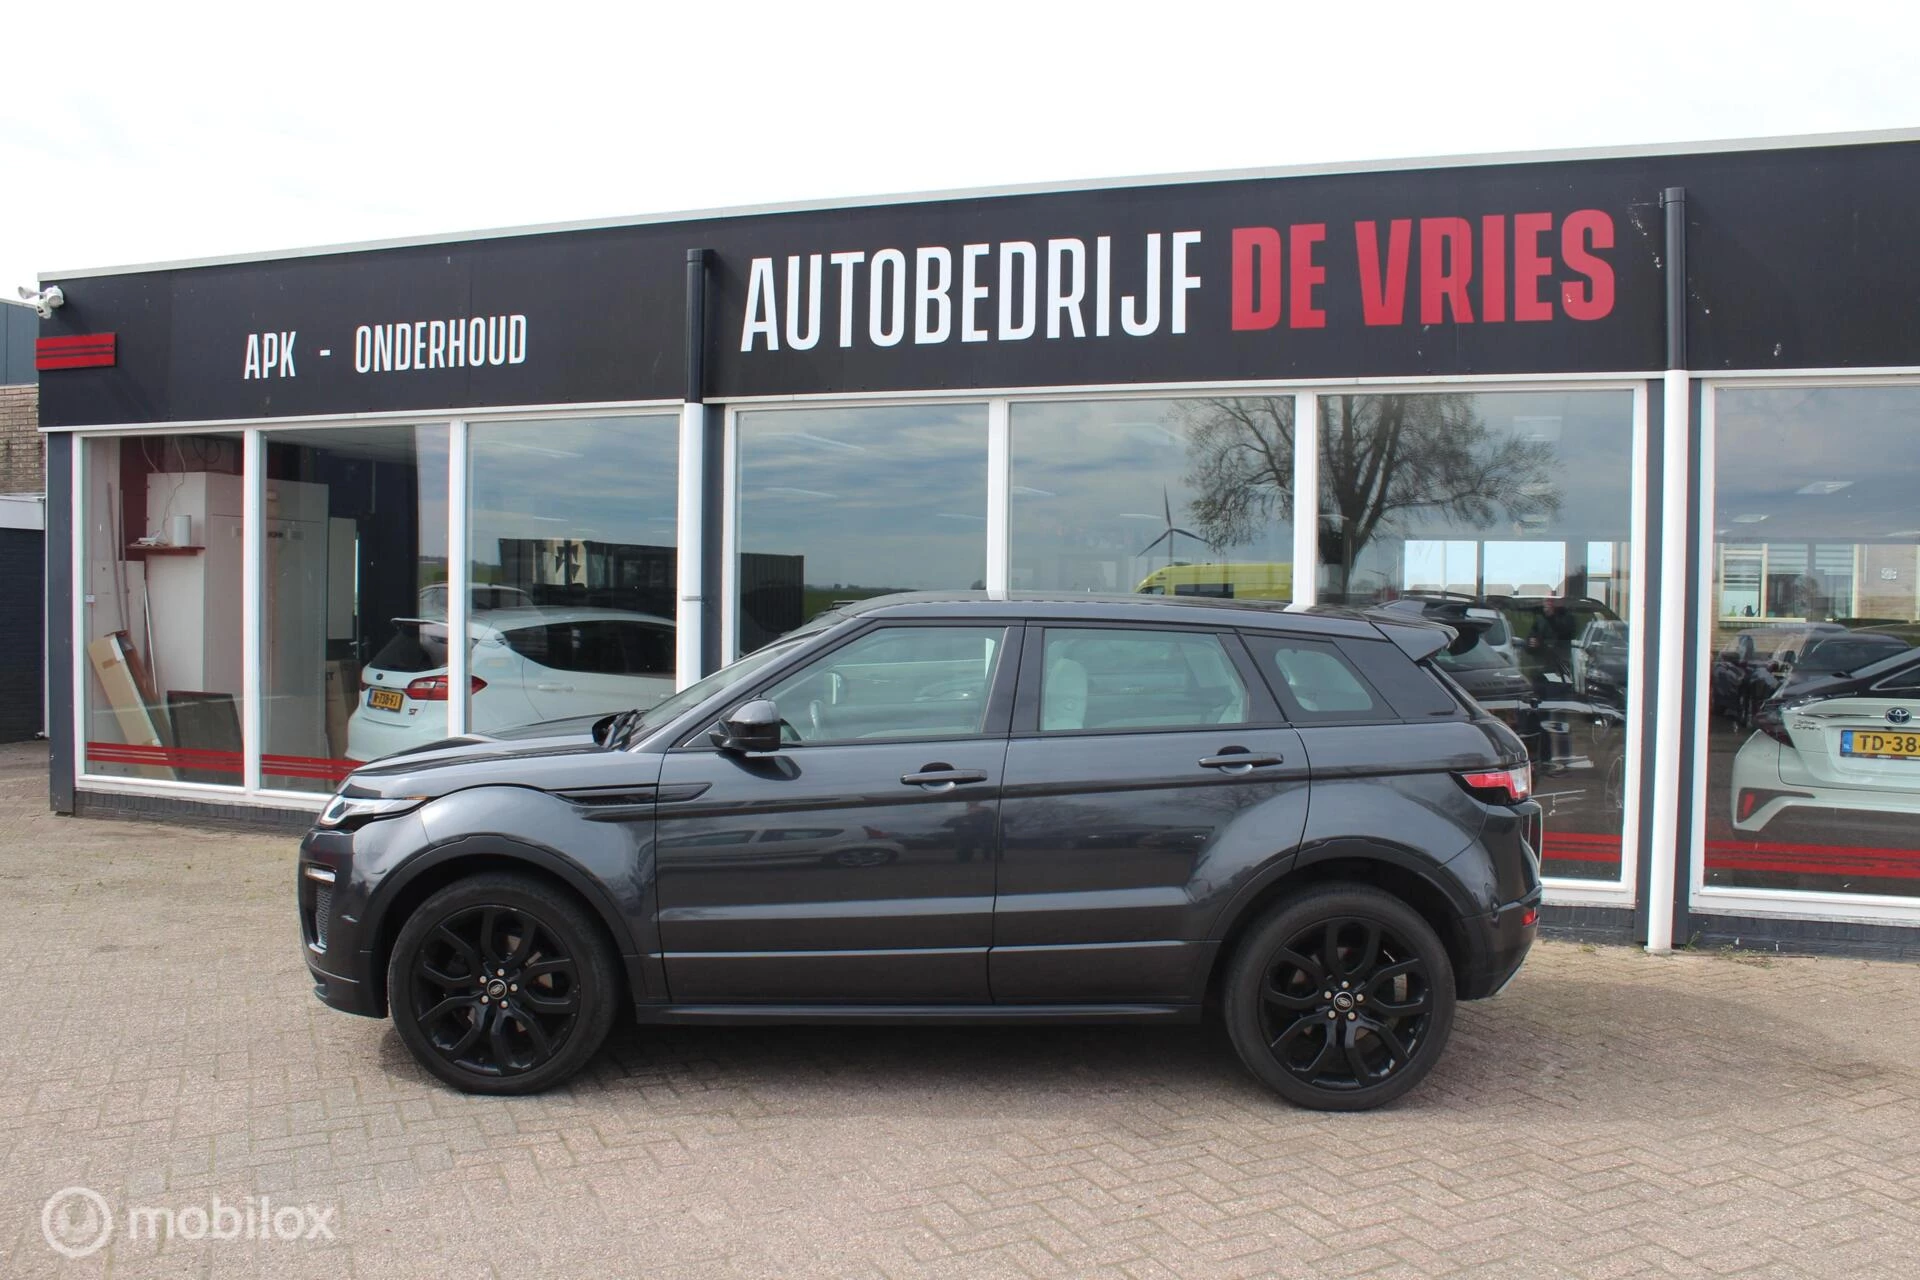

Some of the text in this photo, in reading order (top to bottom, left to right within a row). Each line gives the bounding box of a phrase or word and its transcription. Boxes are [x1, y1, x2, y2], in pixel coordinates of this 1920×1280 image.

[740, 209, 1615, 353] AUTOBEDRIJF DE VRIES
[244, 331, 297, 380] APK
[354, 314, 528, 374] ONDERHOUD
[1859, 735, 1920, 753] TD-38
